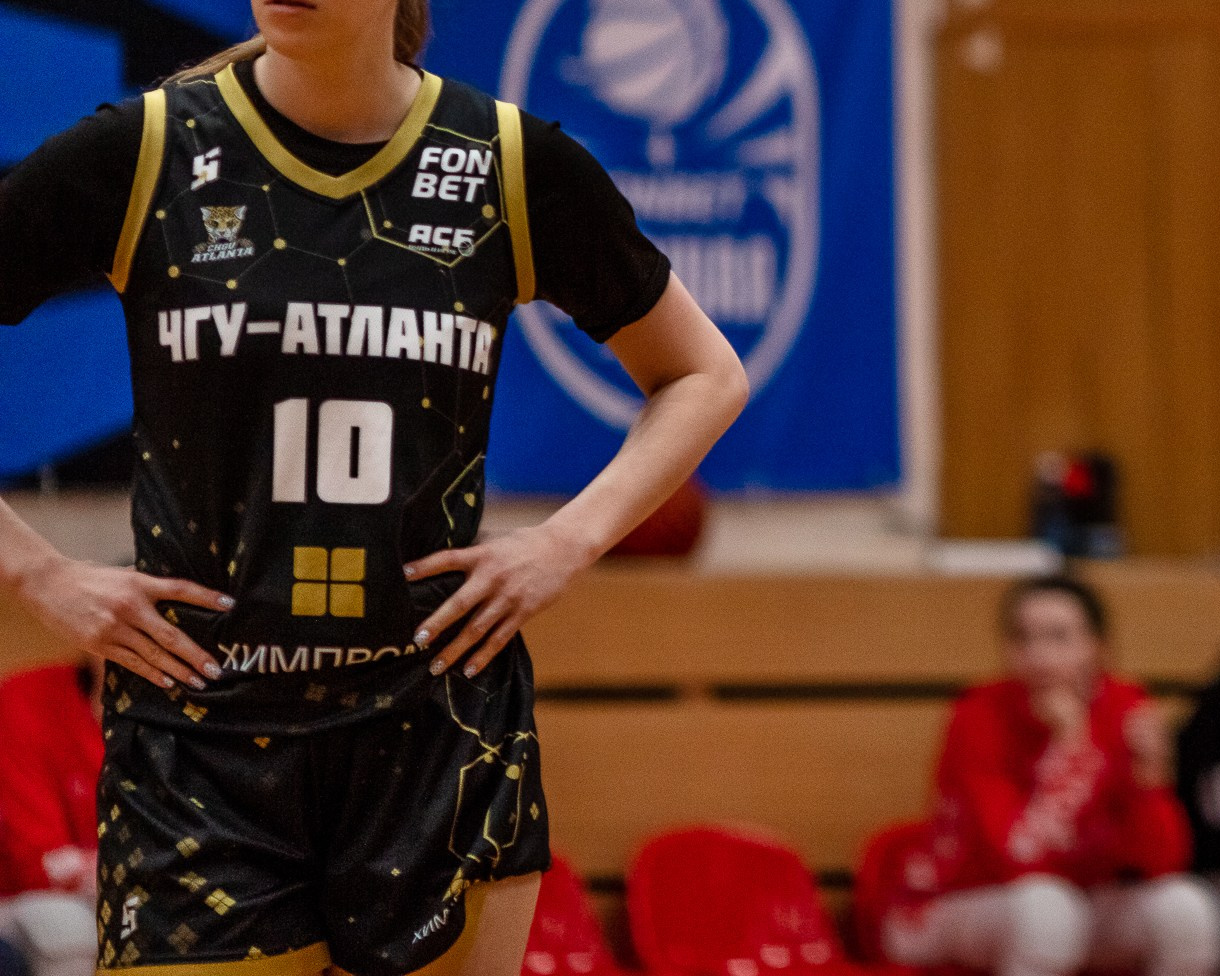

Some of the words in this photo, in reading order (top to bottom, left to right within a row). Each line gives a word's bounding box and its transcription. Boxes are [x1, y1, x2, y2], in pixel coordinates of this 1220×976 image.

[418, 147, 493, 175] FON
[411, 172, 485, 203] BET
[191, 246, 255, 263] ATLANTA
[272, 397, 393, 505] 10
